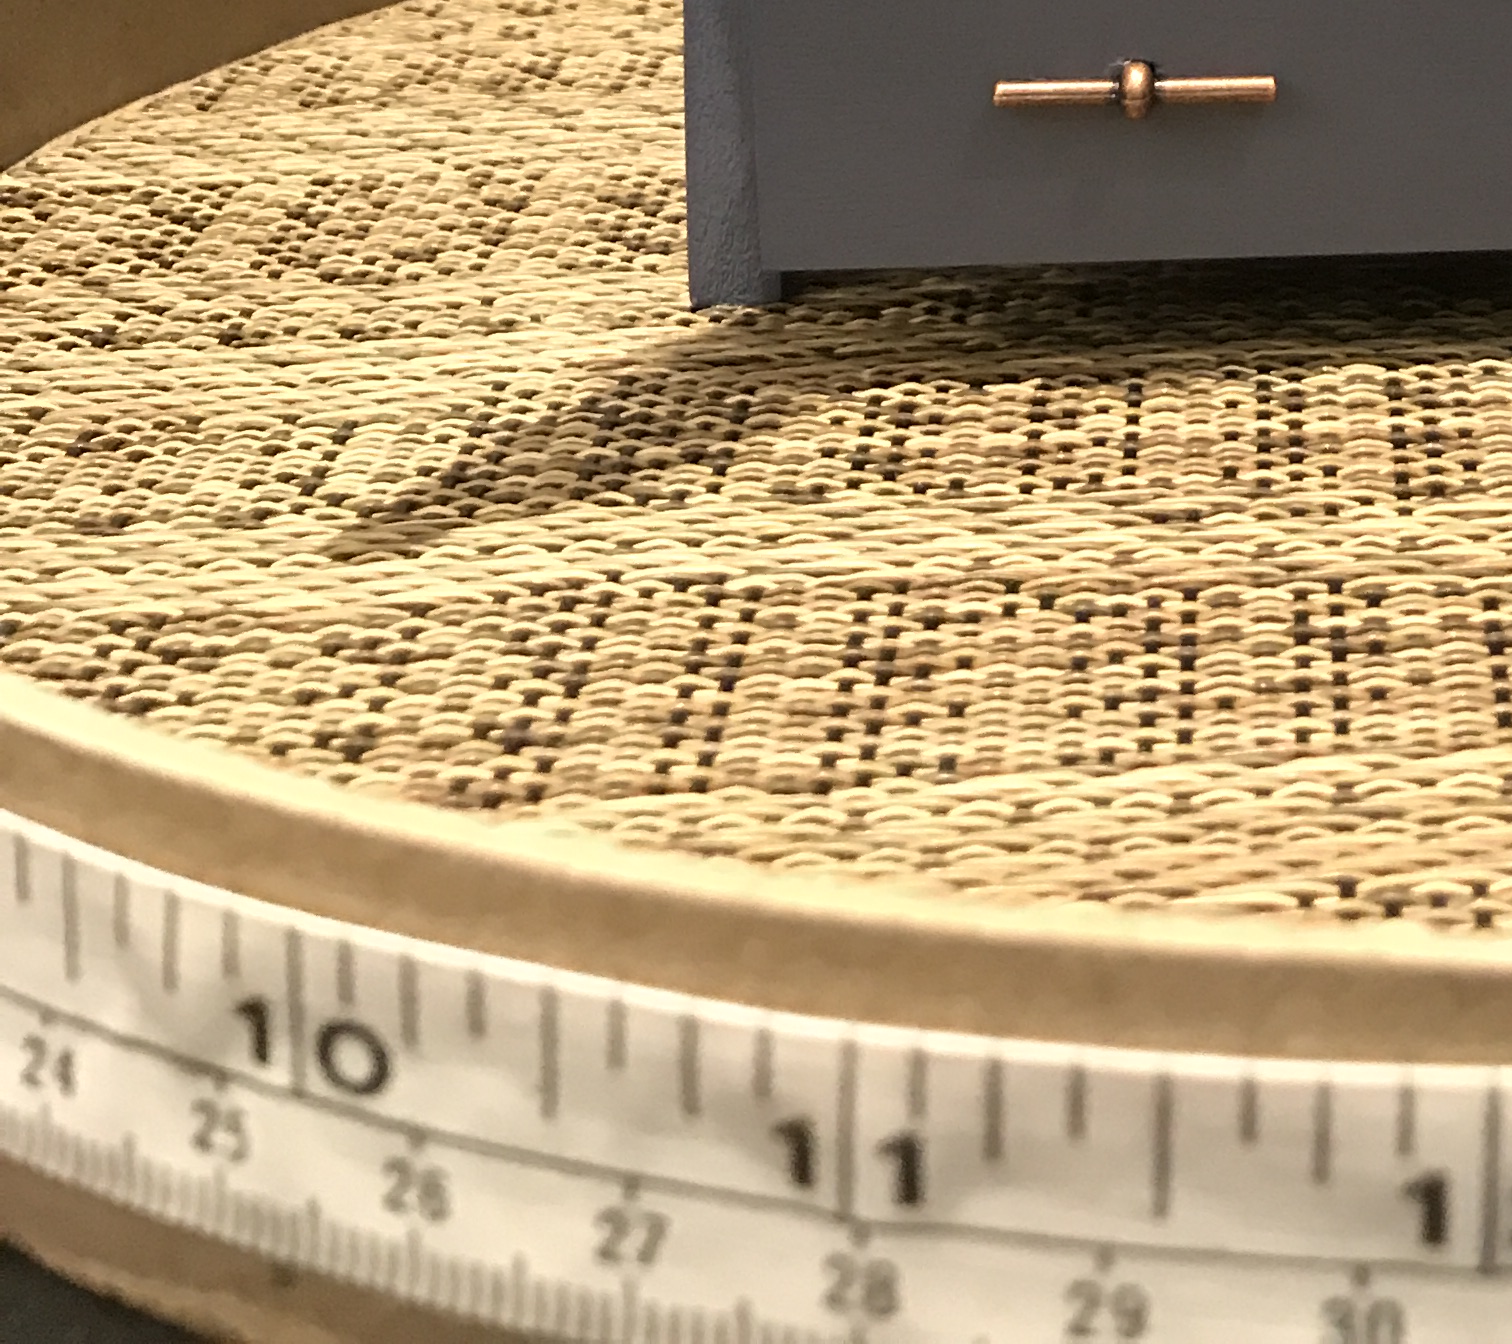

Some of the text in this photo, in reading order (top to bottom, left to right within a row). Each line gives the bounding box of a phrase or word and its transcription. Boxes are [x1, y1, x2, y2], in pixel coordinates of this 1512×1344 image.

[19, 1034, 77, 1097] 24
[380, 1156, 453, 1222] 26
[595, 1206, 672, 1265] 27
[824, 1253, 903, 1316] 28
[1064, 1279, 1150, 1340] 29
[236, 995, 391, 1097] 10
[769, 1116, 926, 1206] 11
